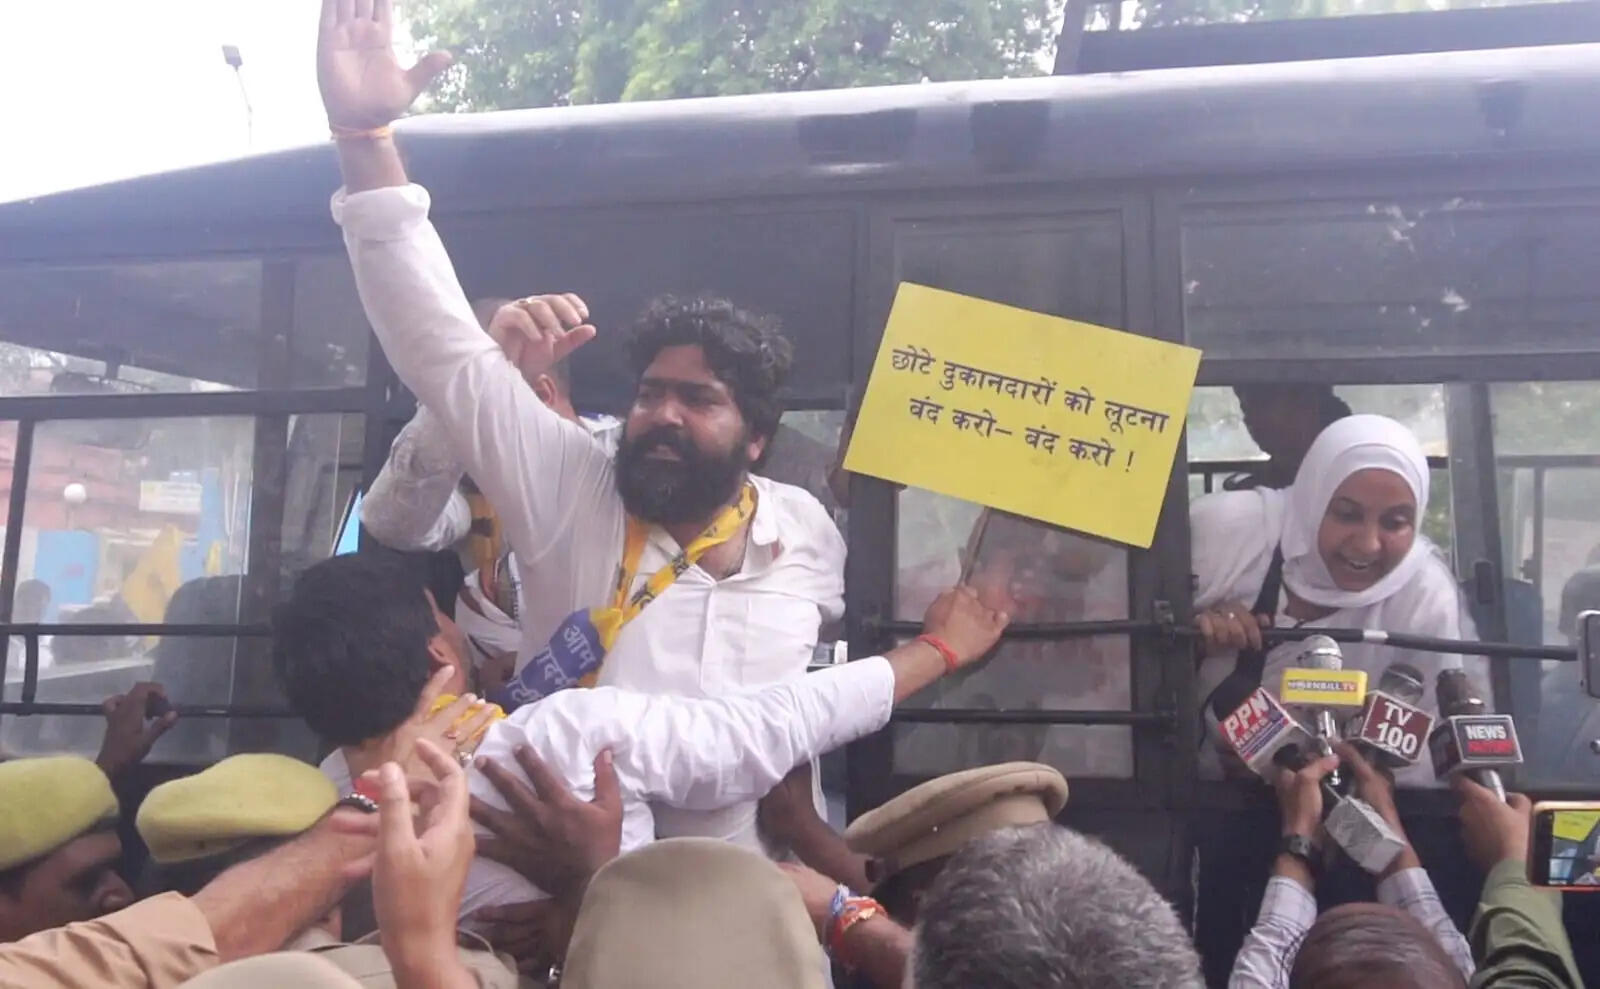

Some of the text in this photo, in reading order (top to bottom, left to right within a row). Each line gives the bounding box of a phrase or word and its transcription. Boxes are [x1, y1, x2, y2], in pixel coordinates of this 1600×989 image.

[892, 345, 1170, 434] छोटे दुकानदारों को लूटना
[909, 395, 945, 425] बंद
[1024, 424, 1061, 455] बंद
[1068, 437, 1116, 467] करो
[1223, 689, 1271, 742] PPN
[1384, 701, 1413, 726] TV
[1465, 724, 1507, 740] NEWS
[1376, 722, 1418, 754] 100
